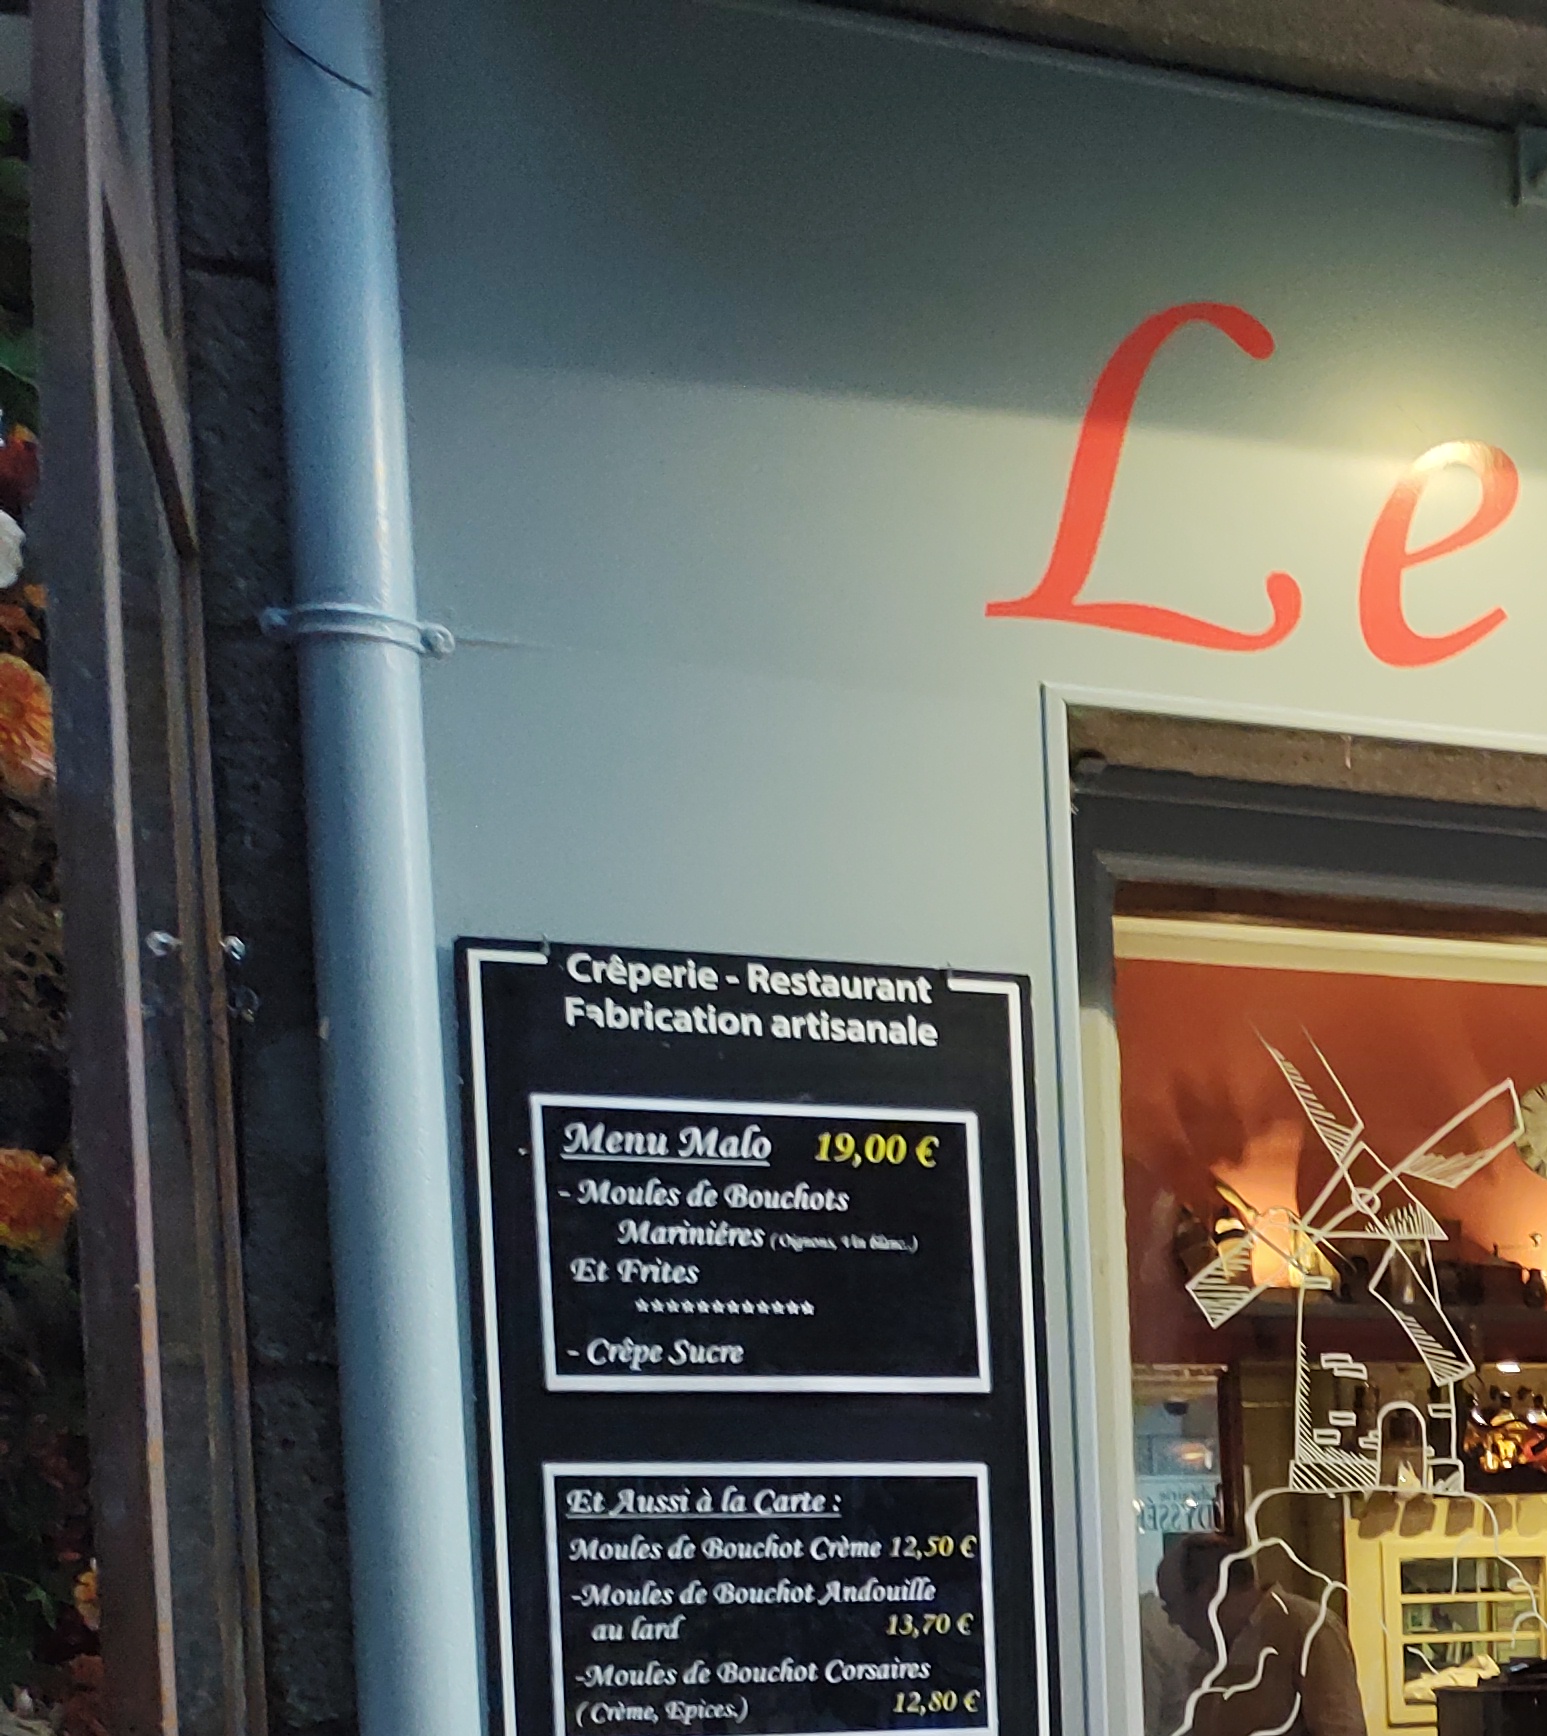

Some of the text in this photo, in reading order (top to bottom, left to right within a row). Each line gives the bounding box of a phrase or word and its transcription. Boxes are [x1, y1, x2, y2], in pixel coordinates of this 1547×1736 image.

[985, 301, 1519, 667] Le
[567, 952, 718, 993] Crêperie
[747, 962, 932, 1003] Restaurant
[564, 996, 939, 1047] Fabrication artisanale
[563, 1121, 939, 1167] Menu Malo 19,00 €
[577, 1179, 681, 1208] Moules
[686, 1181, 718, 1210] de
[723, 1182, 850, 1213] Bouchots
[570, 1258, 700, 1286] Et Frites
[586, 1338, 662, 1371] Crêpe
[667, 1339, 744, 1365] Sucre
[566, 1490, 605, 1514] Et
[609, 1489, 688, 1517] Aussi
[699, 1489, 714, 1513] à
[721, 1486, 746, 1513] la
[753, 1489, 825, 1516] Carte
[569, 1535, 662, 1561] Moules
[667, 1536, 696, 1560] de
[701, 1534, 804, 1560] Bouchot
[809, 1535, 882, 1559] Crème
[888, 1535, 954, 1562] 12,50
[680, 1582, 708, 1607] de
[713, 1580, 816, 1606] Bouchot
[818, 1578, 937, 1607] Andouille
[592, 1619, 623, 1643] au
[631, 1613, 686, 1641] lard
[885, 1612, 951, 1639] 13,70
[682, 1659, 711, 1685] de
[716, 1658, 818, 1685] Bouchot
[824, 1656, 931, 1685] Corsaires
[892, 1690, 958, 1715] 12,80
